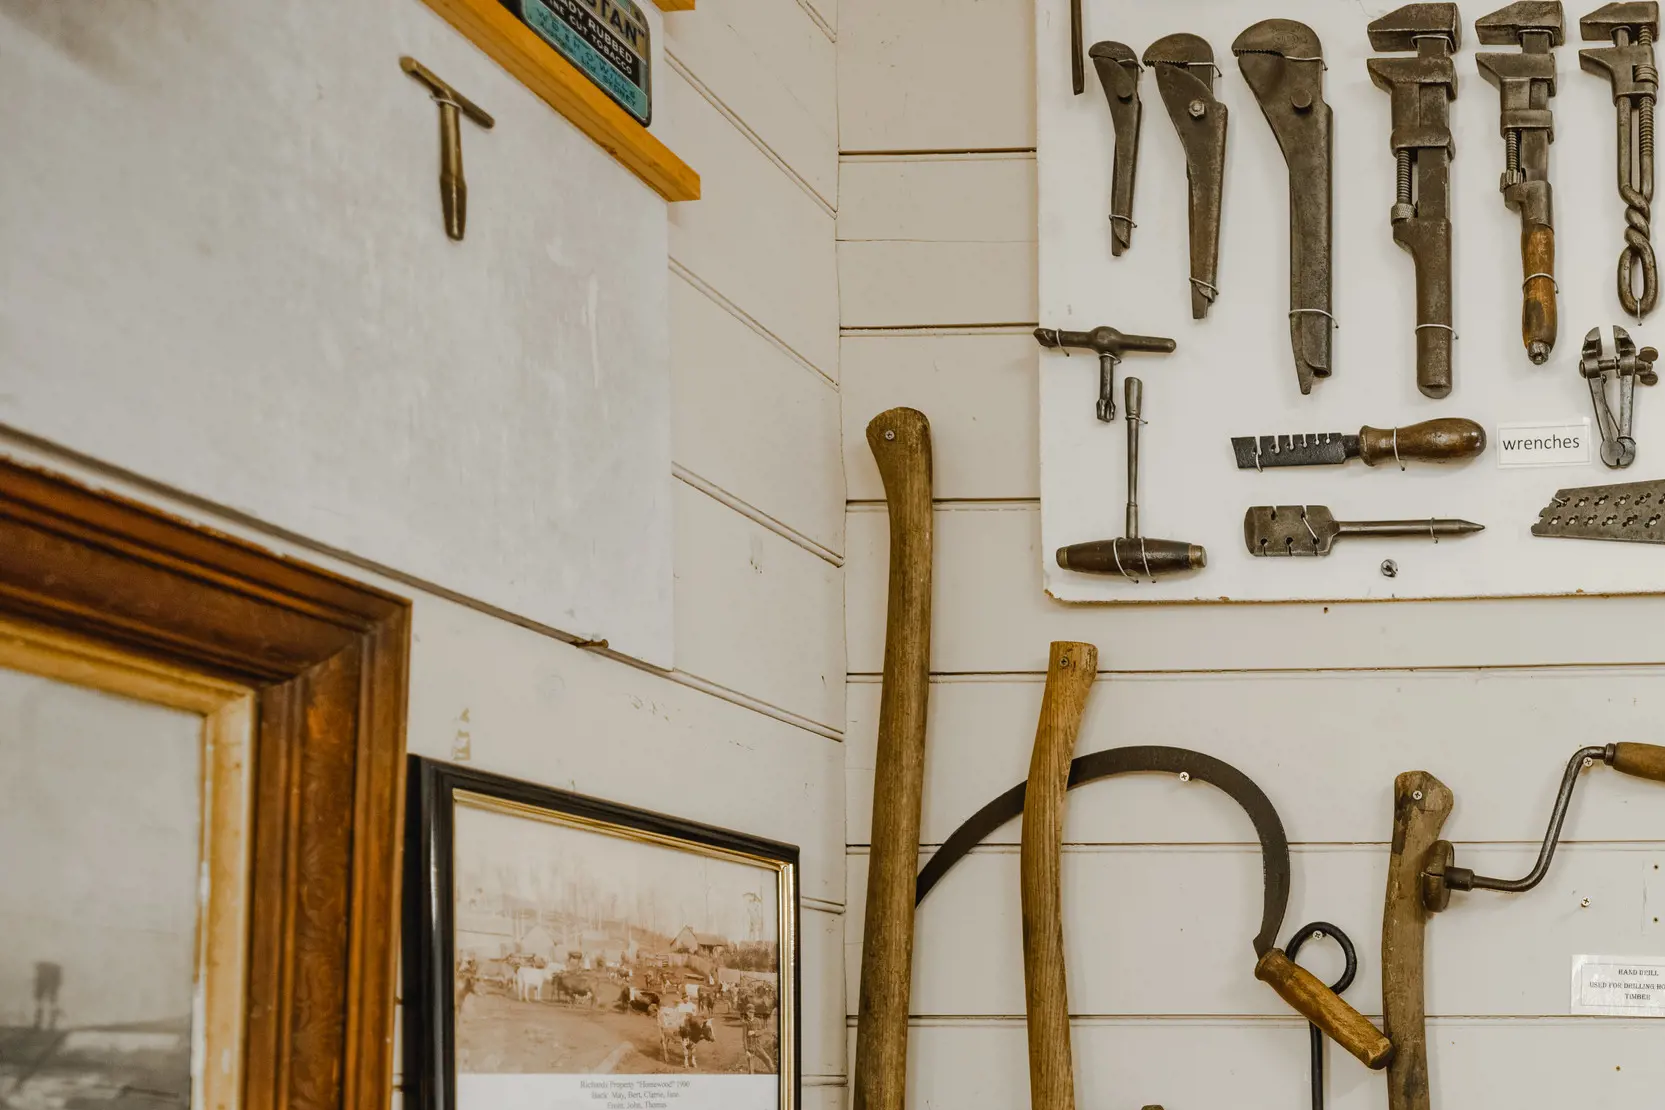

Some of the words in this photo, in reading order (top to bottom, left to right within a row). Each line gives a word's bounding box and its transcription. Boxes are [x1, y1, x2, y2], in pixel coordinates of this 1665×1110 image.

[569, 15, 588, 35] CUT
[592, 34, 632, 75] TOBACCO
[588, 19, 633, 64] RUBBED
[1503, 434, 1580, 450] wrenches
